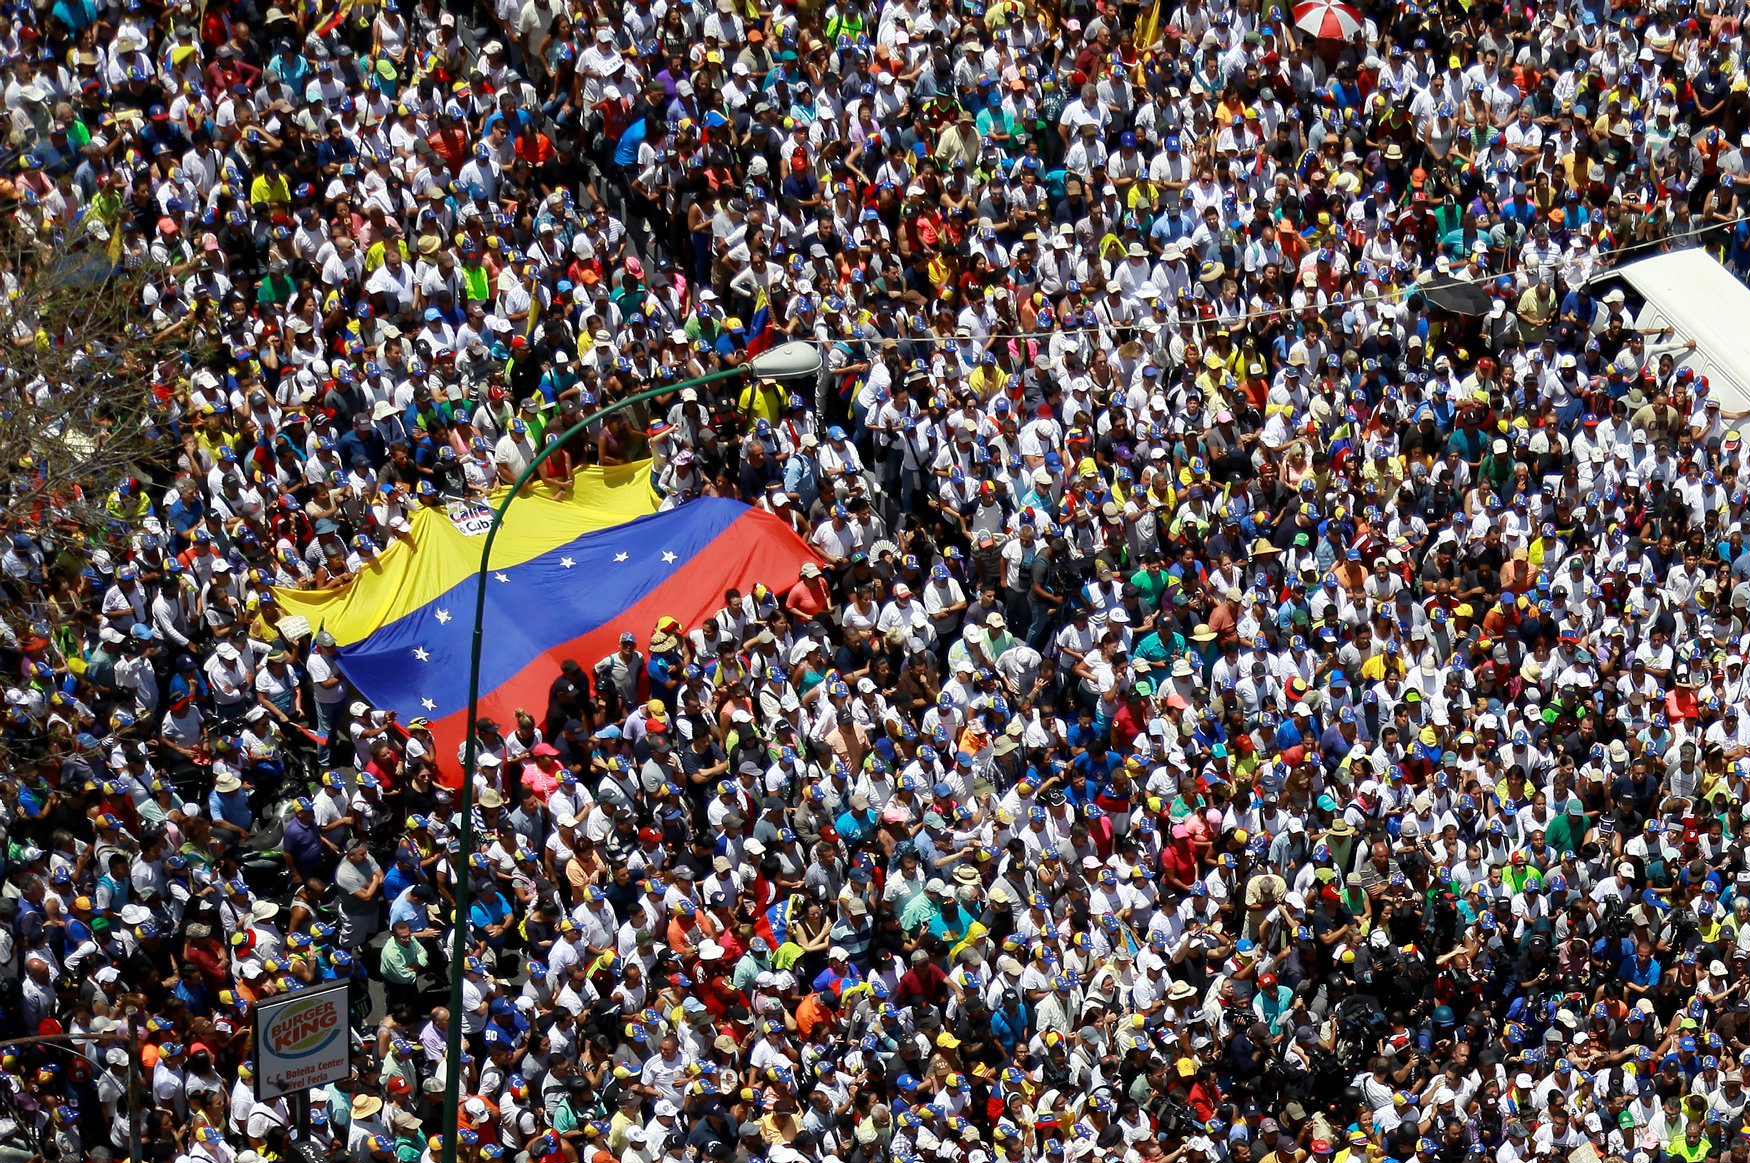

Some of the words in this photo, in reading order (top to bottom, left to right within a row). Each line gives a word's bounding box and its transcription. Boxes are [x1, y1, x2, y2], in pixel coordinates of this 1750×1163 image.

[449, 505, 491, 524] Calle
[271, 1001, 335, 1039] BURGER
[275, 1010, 338, 1053] KING
[485, 1029, 498, 1041] 90
[318, 1058, 344, 1071] Center
[286, 1078, 305, 1091] ivel
[308, 1073, 328, 1084] Feria
